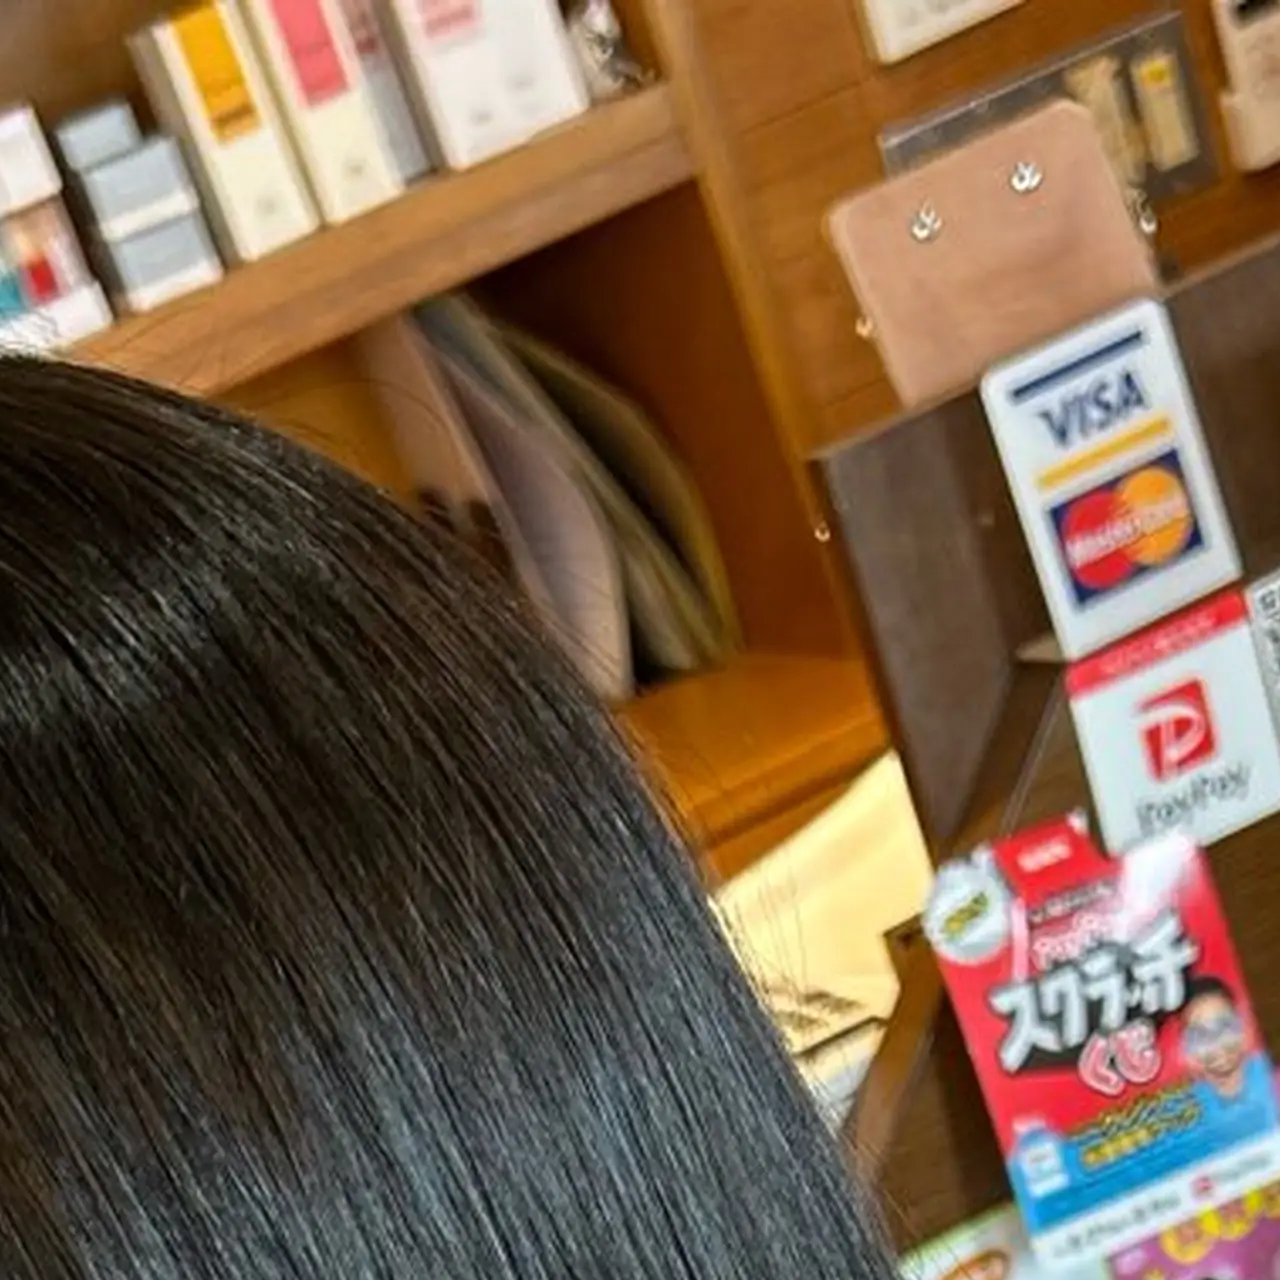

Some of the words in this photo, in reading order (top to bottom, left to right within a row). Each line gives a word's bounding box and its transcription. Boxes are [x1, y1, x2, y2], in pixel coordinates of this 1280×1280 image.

[1037, 368, 1148, 446] VISA
[1135, 762, 1252, 838] PayPay
[986, 910, 1202, 1078] スクラッチ
[1078, 1016, 1163, 1097] くじ
